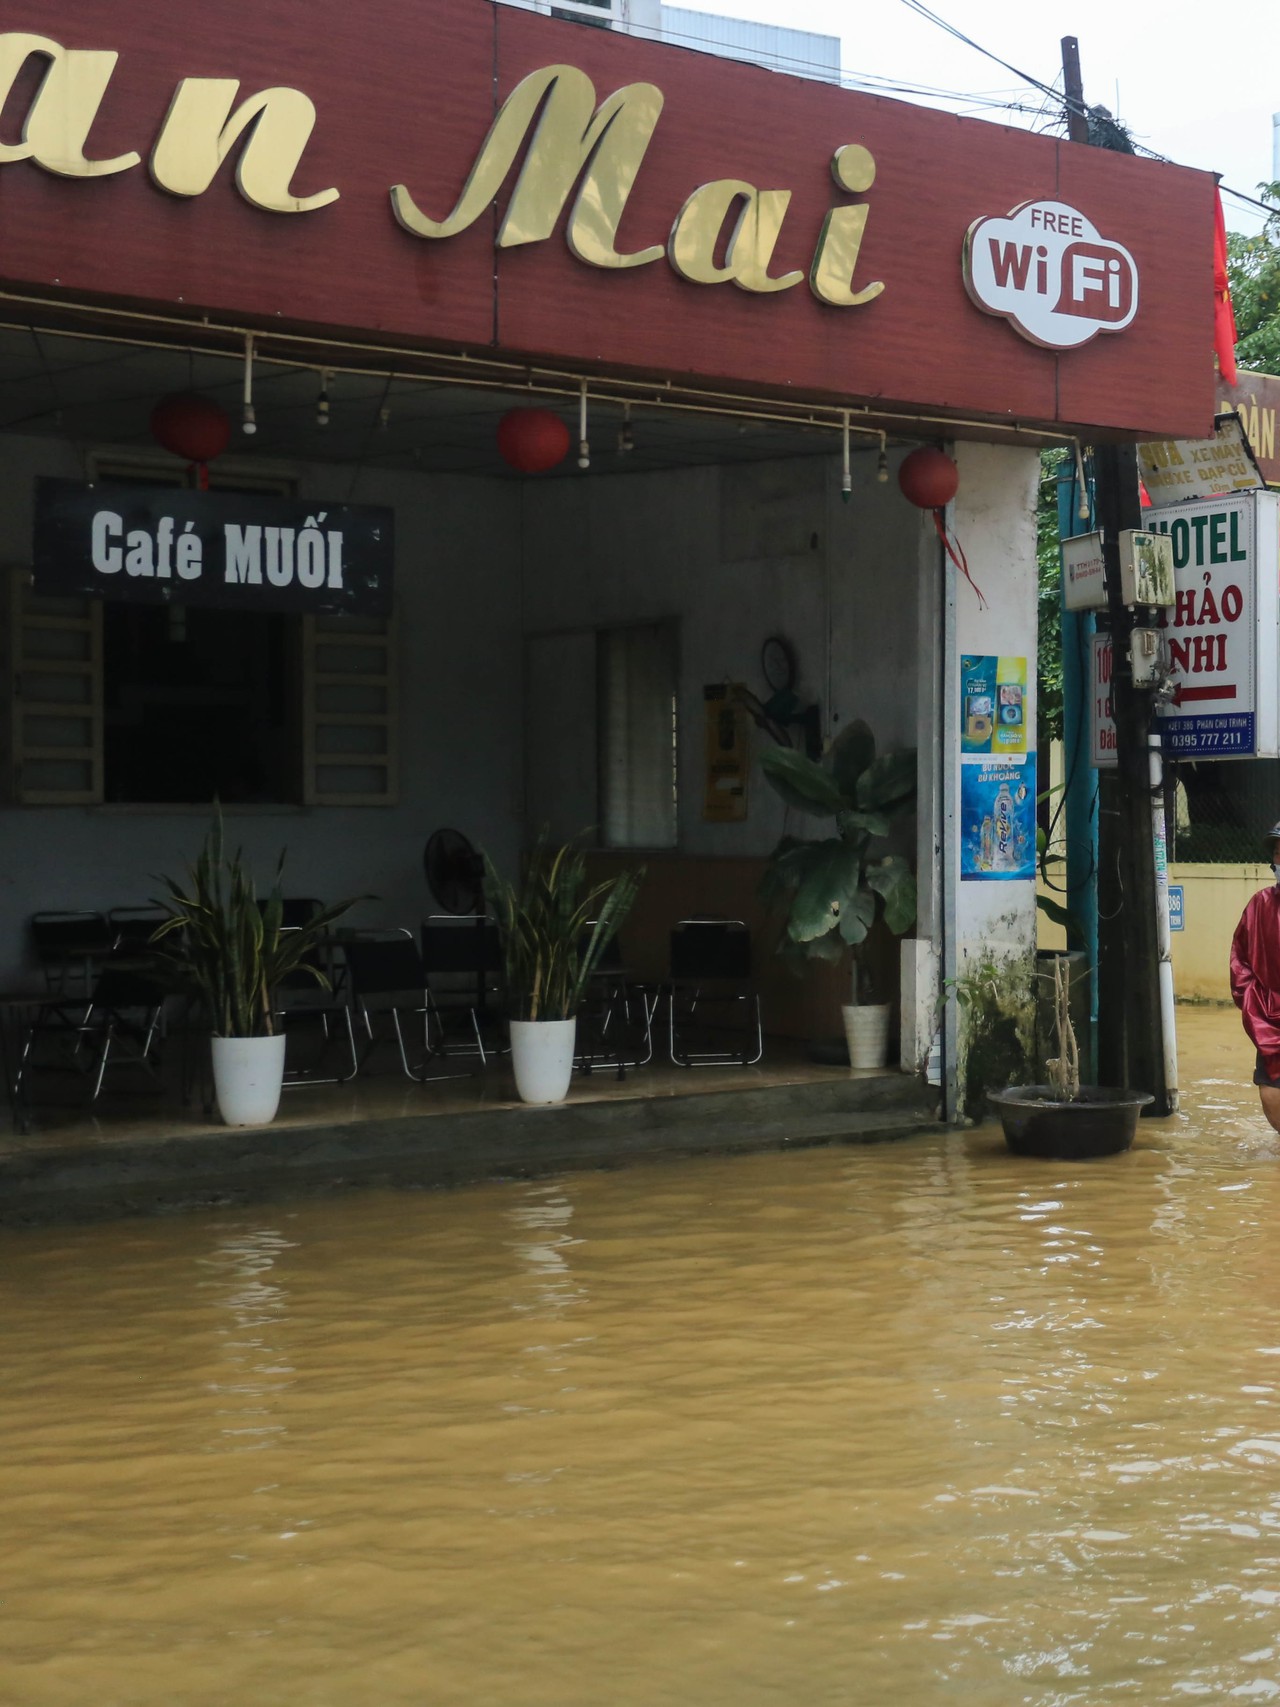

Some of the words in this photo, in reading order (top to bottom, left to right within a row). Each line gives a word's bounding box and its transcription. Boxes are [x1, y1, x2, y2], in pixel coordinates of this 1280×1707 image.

[390, 63, 885, 306] Mai
[1031, 208, 1083, 238] FREE
[92, 511, 202, 580] Café
[224, 511, 343, 589] MUỐI
[1149, 511, 1247, 569] OTEL
[1159, 571, 1243, 629] HẢO
[1168, 634, 1228, 675] NHI
[1172, 734, 1197, 747] 0395
[1200, 733, 1219, 746] 777
[1222, 732, 1241, 745] 211
[1196, 719, 1213, 729] PHAN
[1215, 718, 1227, 729] CHU
